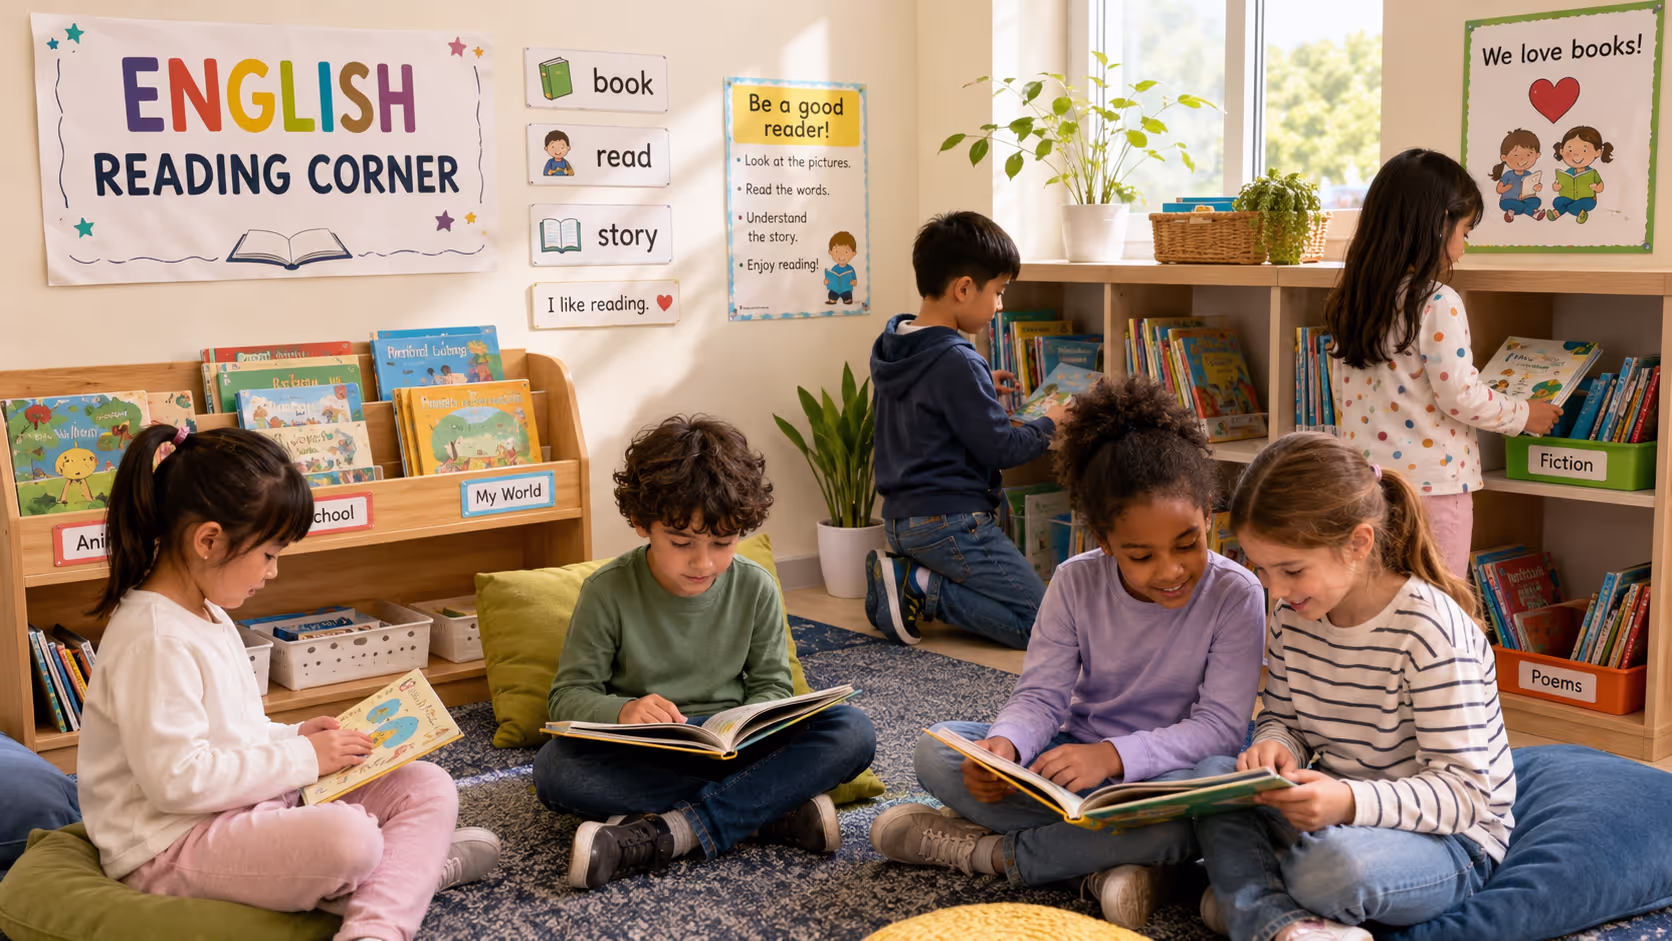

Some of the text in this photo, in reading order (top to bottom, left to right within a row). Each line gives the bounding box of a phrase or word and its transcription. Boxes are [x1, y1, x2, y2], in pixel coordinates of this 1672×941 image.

[1482, 33, 1643, 67] We love books!
[593, 66, 654, 96] book
[121, 56, 416, 134] ENGLISH
[749, 93, 844, 120] Be a good
[765, 120, 828, 138] reader!
[596, 142, 652, 168] read
[745, 154, 851, 170] Look at the pictures.
[93, 152, 460, 197] READING CORNER
[746, 182, 830, 196] Read the words.
[746, 211, 807, 224] Understand
[598, 223, 658, 253] story
[747, 230, 798, 245] the story.
[747, 257, 819, 275] Enjoy reading!
[548, 294, 649, 316] I like reading.
[1540, 453, 1593, 473] Fiction
[476, 482, 542, 507] My World
[314, 504, 354, 523] chool
[76, 532, 105, 552] Ani
[1532, 669, 1582, 694] Poems
